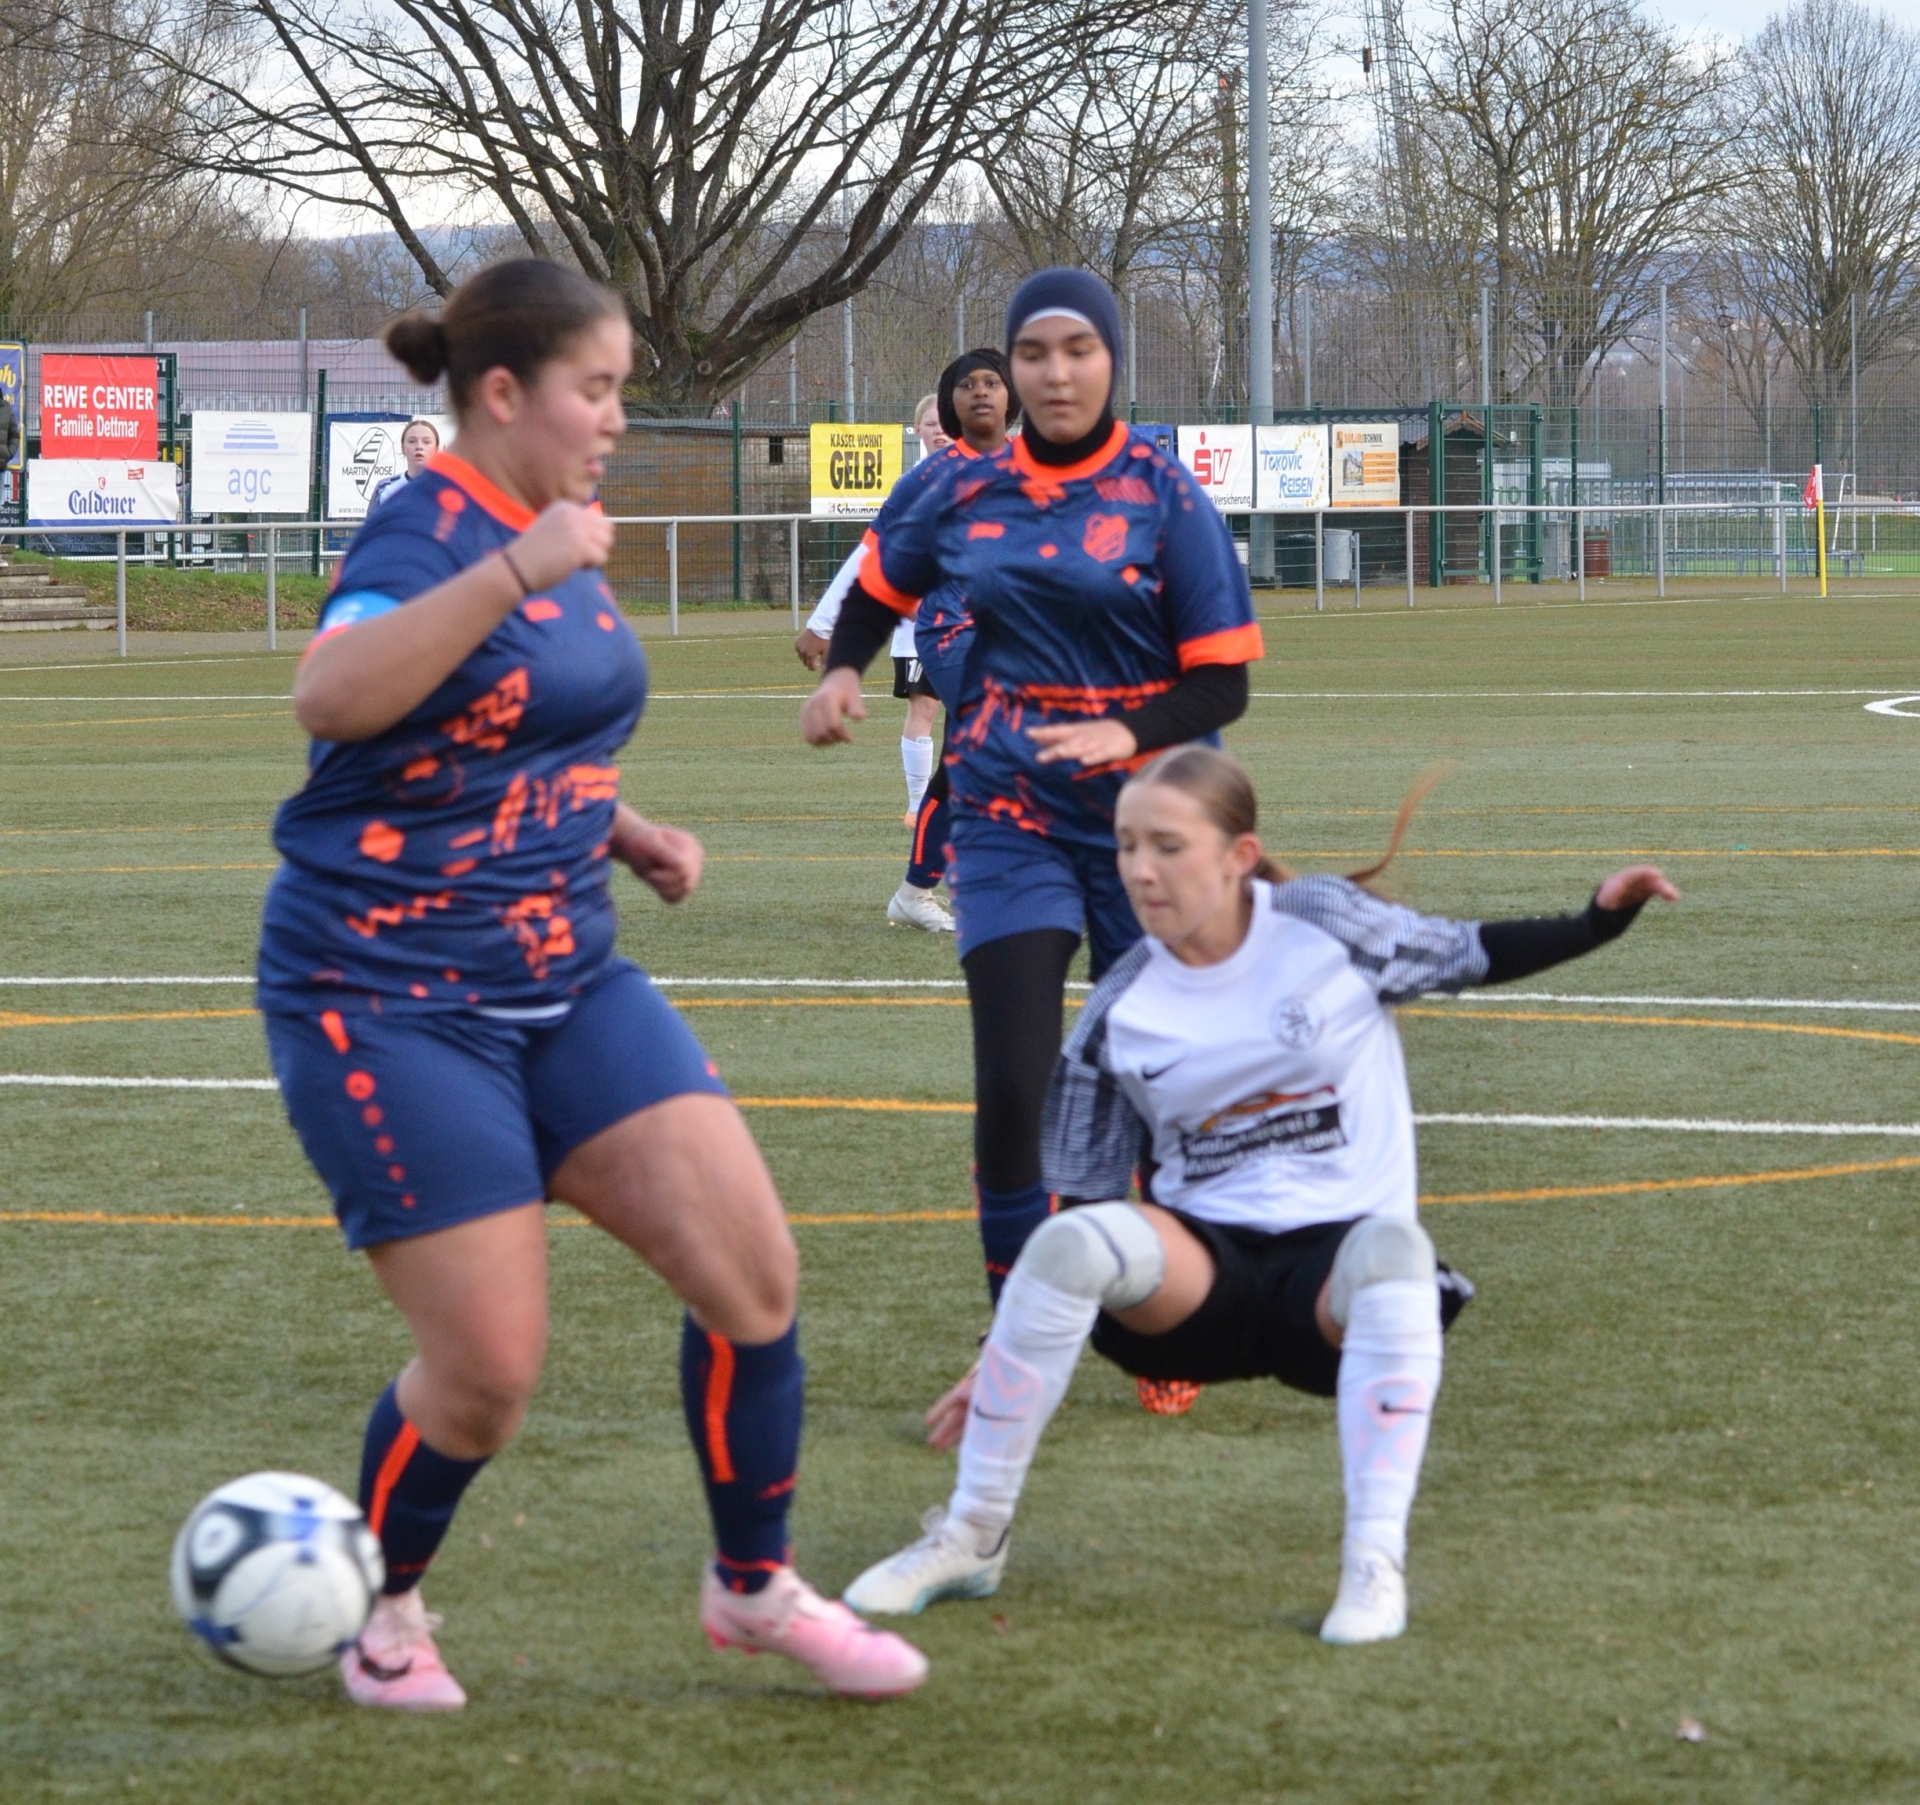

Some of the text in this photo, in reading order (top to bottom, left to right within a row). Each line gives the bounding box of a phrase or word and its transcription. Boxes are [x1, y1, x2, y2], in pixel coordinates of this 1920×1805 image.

[44, 384, 88, 409] REWE
[92, 385, 155, 411] CENTER
[54, 413, 139, 438] Familie Dettmar
[830, 433, 883, 448] KASSEL WOHNT
[341, 466, 393, 476] MARTIN ROSE
[829, 449, 883, 490] GELB!
[1194, 448, 1233, 486] SV
[227, 468, 271, 503] agc
[1279, 473, 1314, 498] REISEN
[68, 489, 136, 515] Caldener
